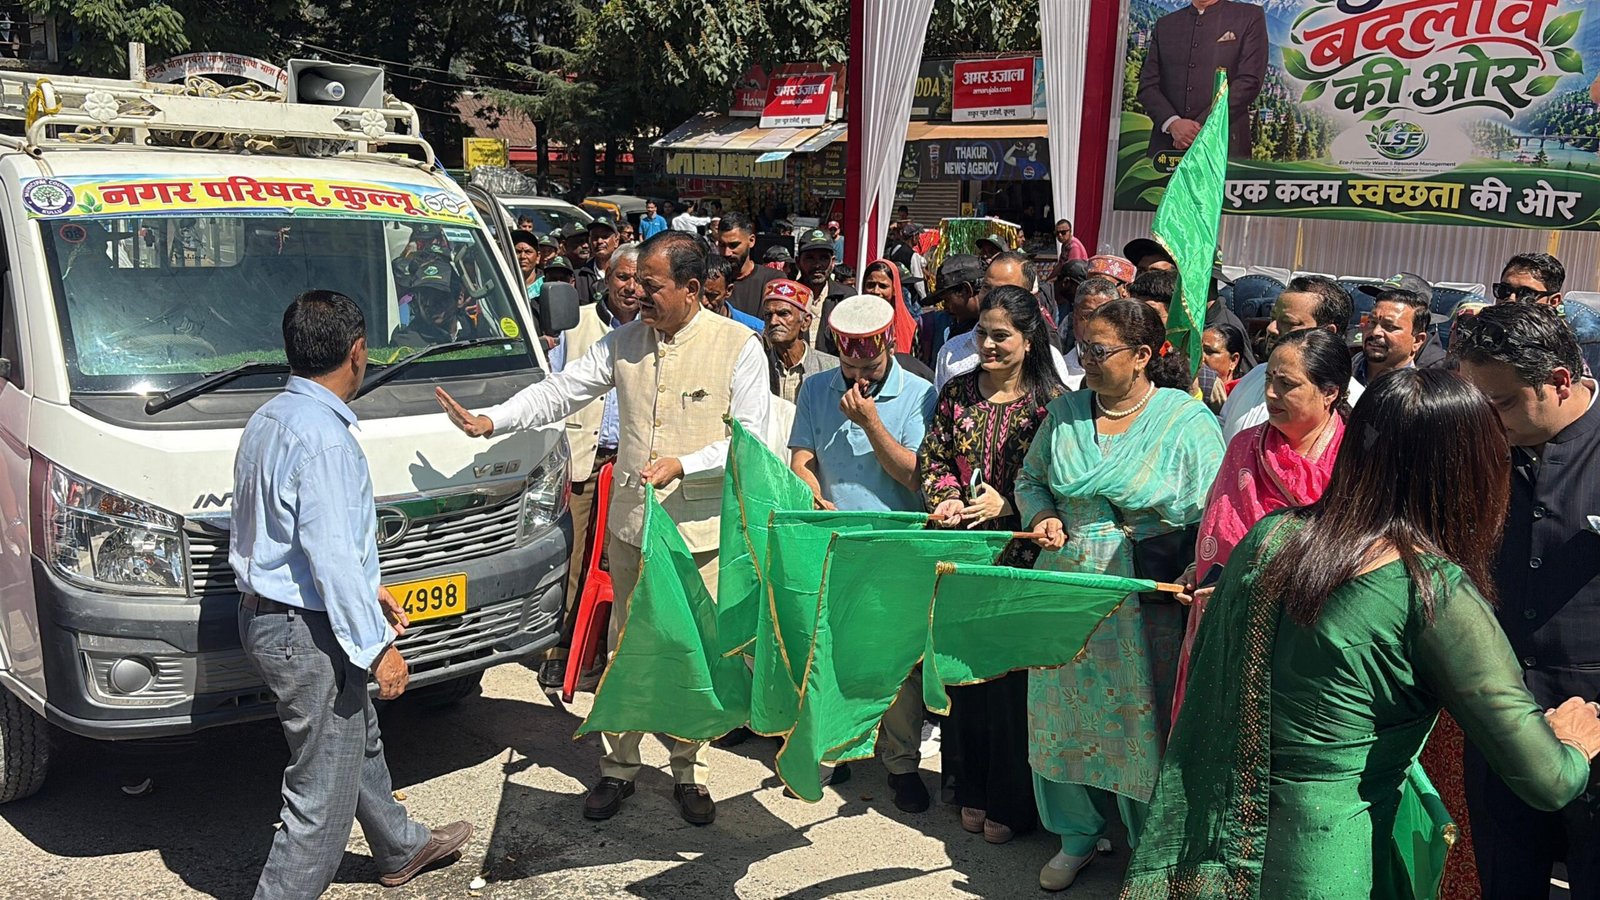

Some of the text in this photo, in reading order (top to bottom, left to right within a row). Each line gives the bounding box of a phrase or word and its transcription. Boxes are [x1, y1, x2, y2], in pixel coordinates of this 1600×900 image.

[1303, 0, 1558, 70] बदलाव
[961, 68, 1025, 85] अमर उजाला
[1332, 44, 1540, 113] की ओर
[773, 83, 826, 97] अमर उजाला
[914, 77, 941, 97] DDA
[972, 86, 1012, 96] amarujala.com
[1379, 132, 1422, 146] LSE
[955, 146, 988, 160] THAKUR
[944, 161, 1000, 175] NEWS AGENCY
[98, 183, 197, 206] नगर
[328, 184, 430, 216] कुल्लू
[1224, 176, 1582, 220] एक कदम स्वच्छता की ओर
[473, 459, 521, 479] V30
[402, 583, 458, 615] 4998
